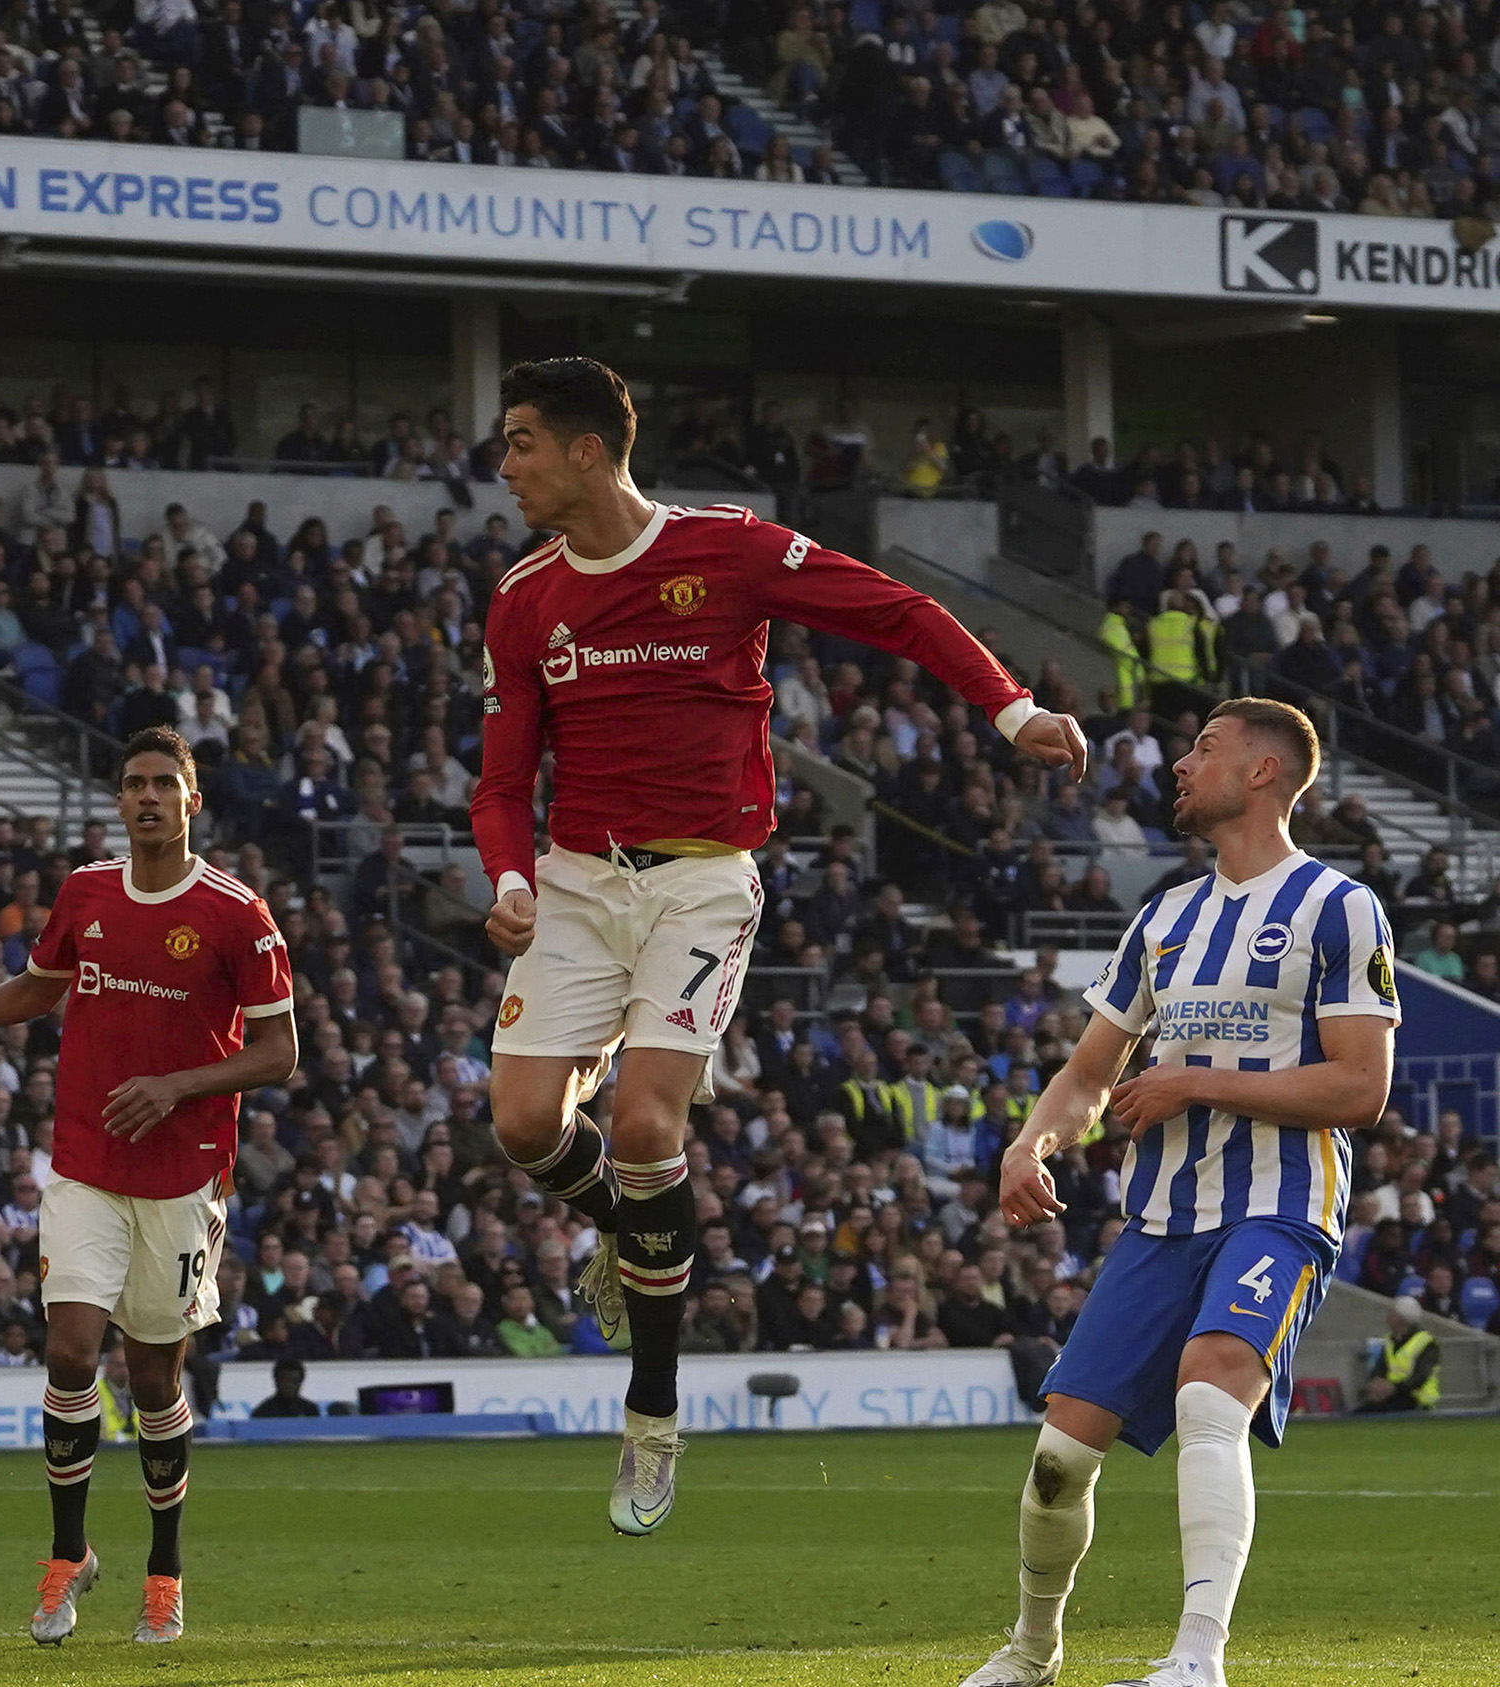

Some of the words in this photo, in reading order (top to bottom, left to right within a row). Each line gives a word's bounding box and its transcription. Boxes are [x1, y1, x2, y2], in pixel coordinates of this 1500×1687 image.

[39, 169, 283, 225] EXPRESS
[308, 185, 657, 244] COMMUNITY
[686, 206, 930, 259] STADIUM
[1336, 239, 1500, 289] KENDRI
[579, 642, 710, 667] TeamViewer
[101, 973, 190, 1001] TeamViewer
[680, 946, 721, 1001] 7
[665, 1014, 697, 1035] adidas
[1159, 1000, 1269, 1021] AMERICAN
[1160, 1022, 1270, 1042] EXPRESS
[177, 1248, 206, 1298] 19
[1237, 1255, 1275, 1304] 4
[859, 1385, 1017, 1426] STADI
